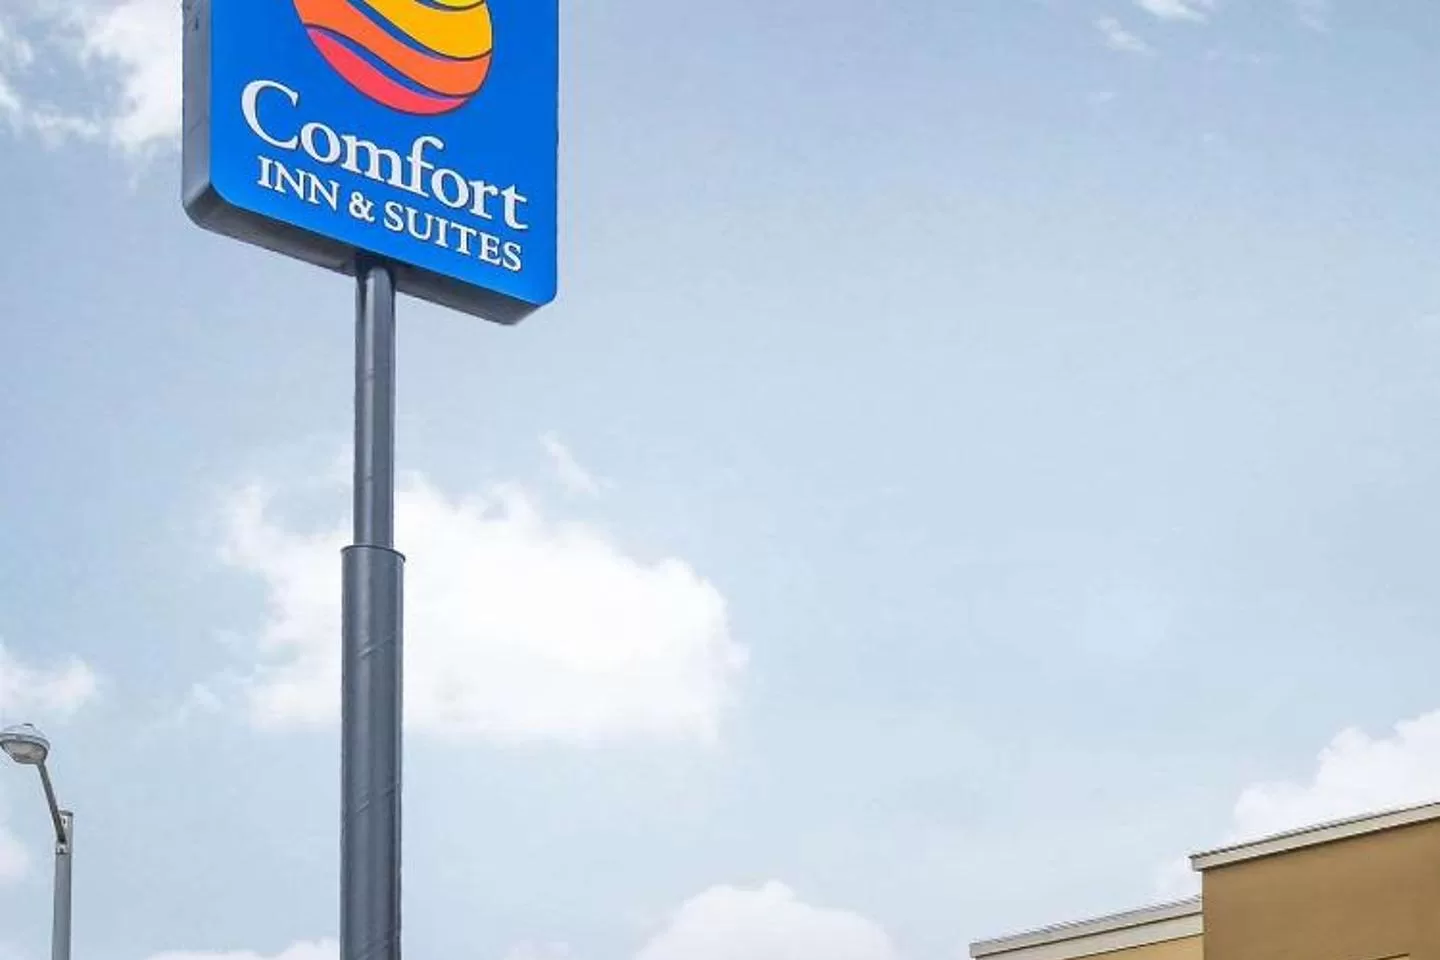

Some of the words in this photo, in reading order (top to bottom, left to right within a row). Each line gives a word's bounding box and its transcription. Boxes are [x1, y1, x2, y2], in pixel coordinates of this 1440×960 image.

[240, 79, 530, 231] Comfort
[257, 155, 340, 211] INN
[349, 191, 375, 223] &
[384, 200, 522, 272] SUITES
